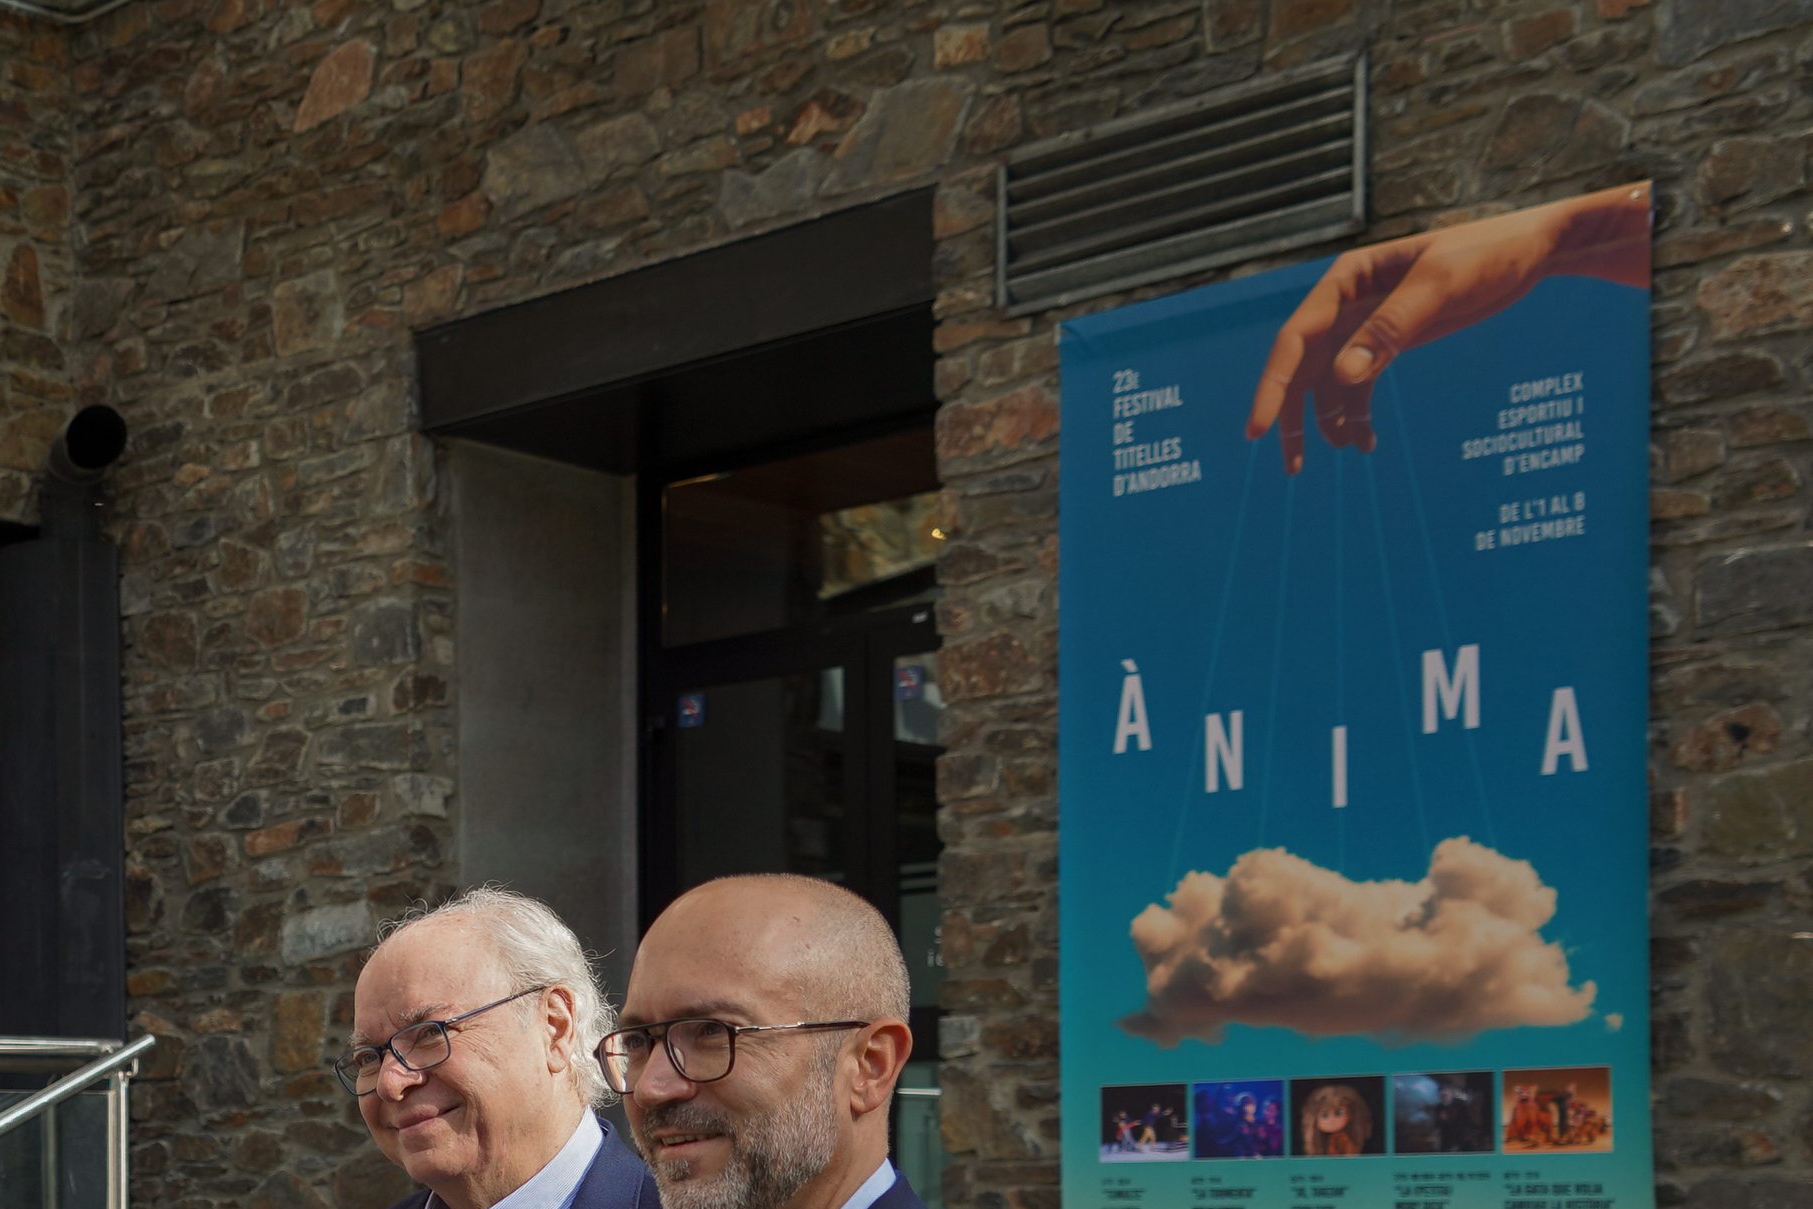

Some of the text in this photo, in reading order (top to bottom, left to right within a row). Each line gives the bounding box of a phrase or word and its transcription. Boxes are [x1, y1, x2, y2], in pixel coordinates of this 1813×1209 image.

[1113, 384, 1183, 419] FESTIVAL
[1510, 372, 1584, 404] COMPLEX
[1498, 399, 1573, 430] ESPORTIU
[1113, 420, 1135, 446] DE
[1462, 421, 1585, 460] SOCIOCULTURAL
[1113, 436, 1182, 471] TITELLES
[1503, 443, 1585, 476] D'ENCAMP
[1113, 459, 1202, 497] D'ANDORRA
[1500, 502, 1521, 524] DE
[1550, 493, 1571, 516] AL
[1573, 491, 1585, 511] 8
[1475, 515, 1585, 551] DE NOVEMBRE
